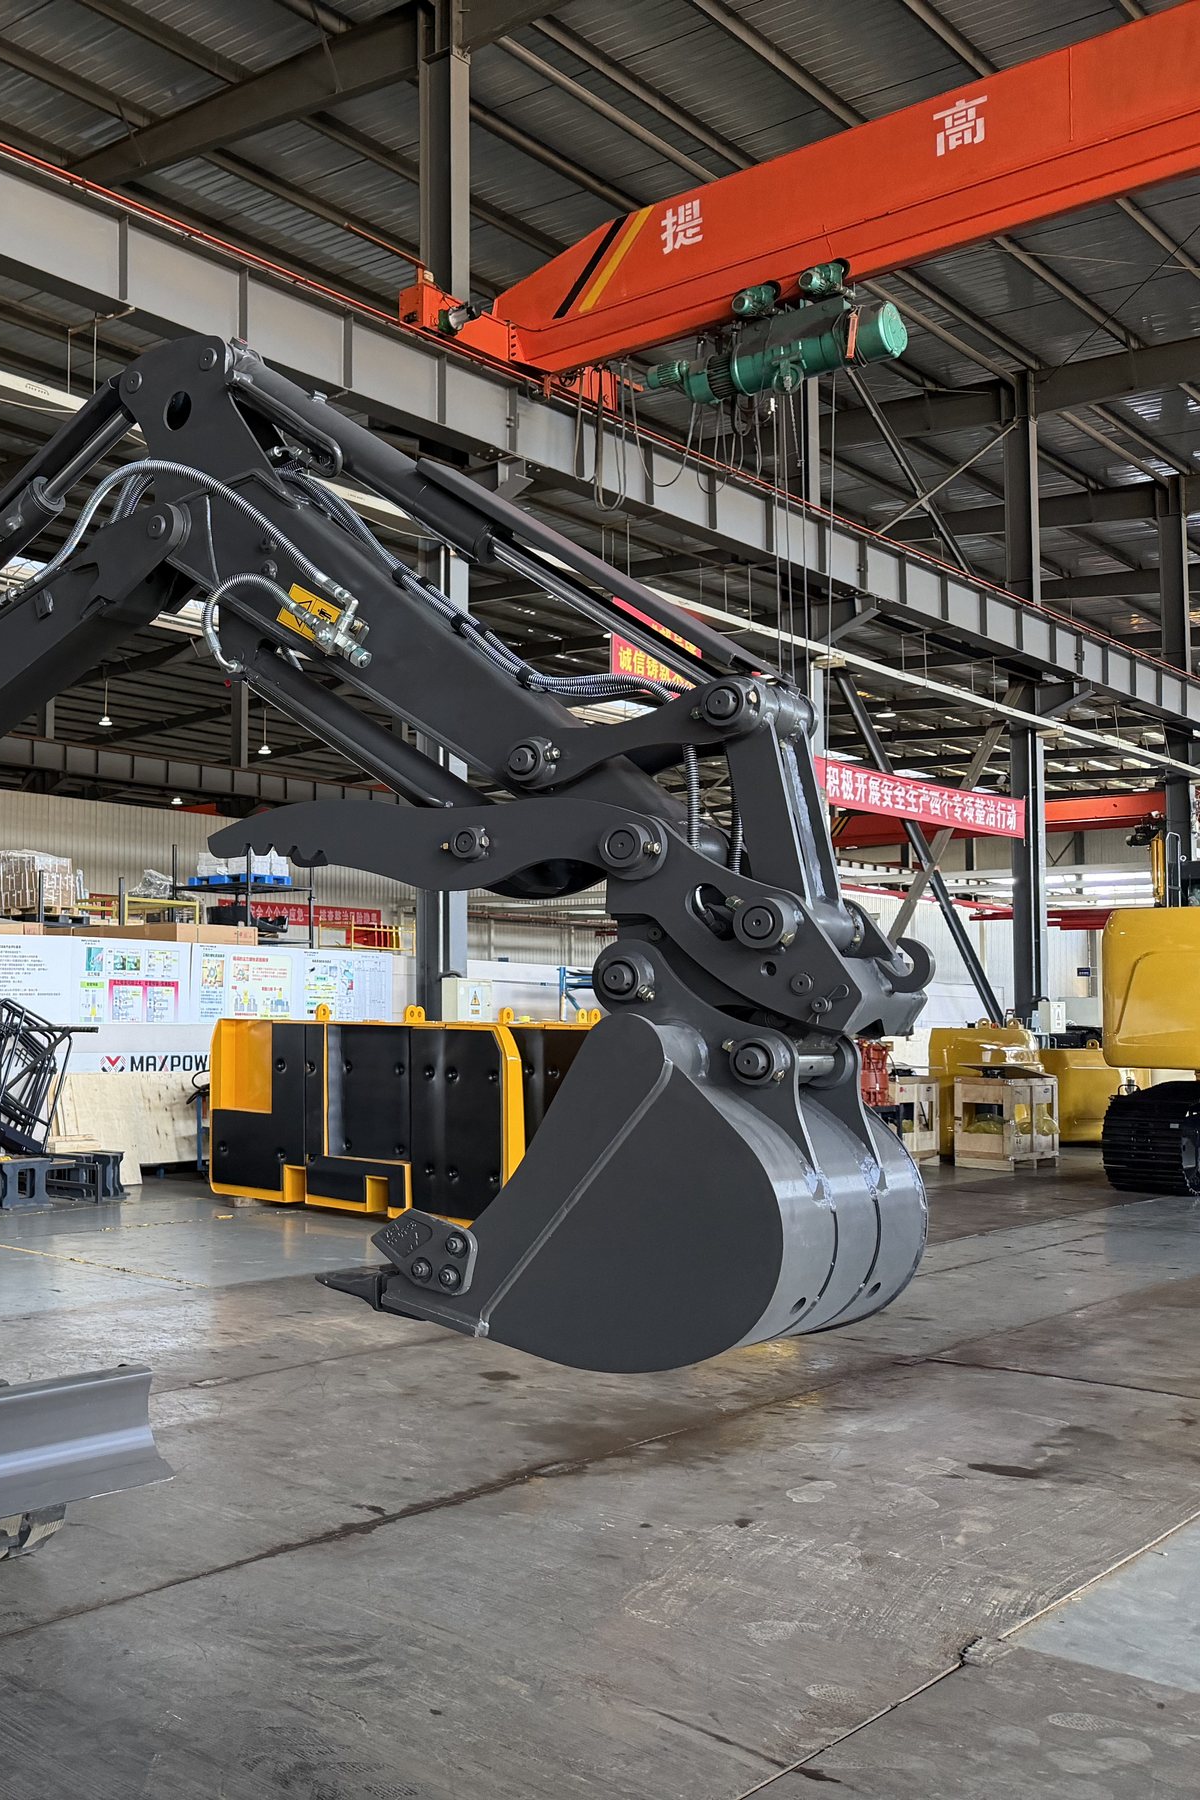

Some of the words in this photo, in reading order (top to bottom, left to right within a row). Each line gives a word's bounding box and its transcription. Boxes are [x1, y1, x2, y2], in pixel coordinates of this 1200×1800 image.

[660, 198, 704, 256] 提
[932, 94, 988, 157] 高
[130, 1054, 211, 1072] MAXPOW
